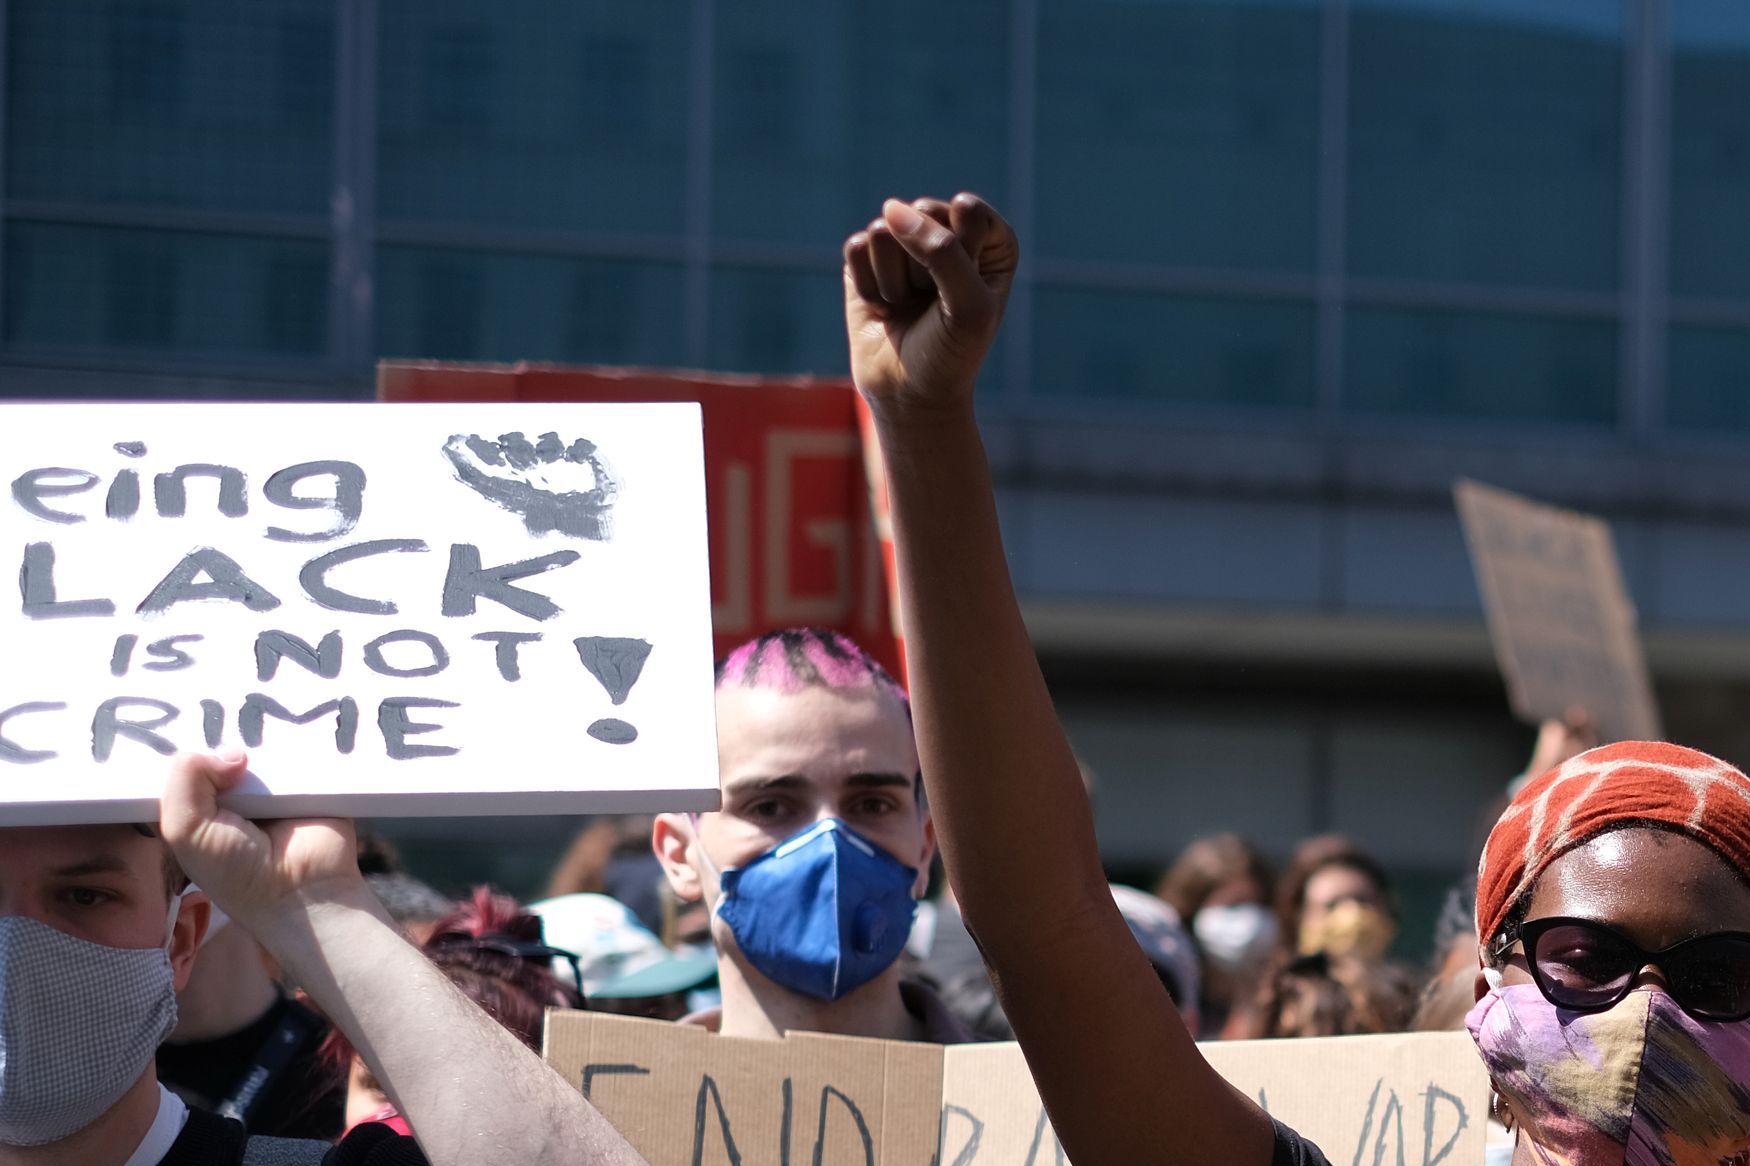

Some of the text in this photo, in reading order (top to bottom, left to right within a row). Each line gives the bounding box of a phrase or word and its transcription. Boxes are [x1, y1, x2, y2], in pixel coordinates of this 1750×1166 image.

[11, 440, 369, 542] eing
[18, 537, 582, 622] LACK
[111, 628, 545, 683] IS NOT
[0, 694, 463, 763] CRIME
